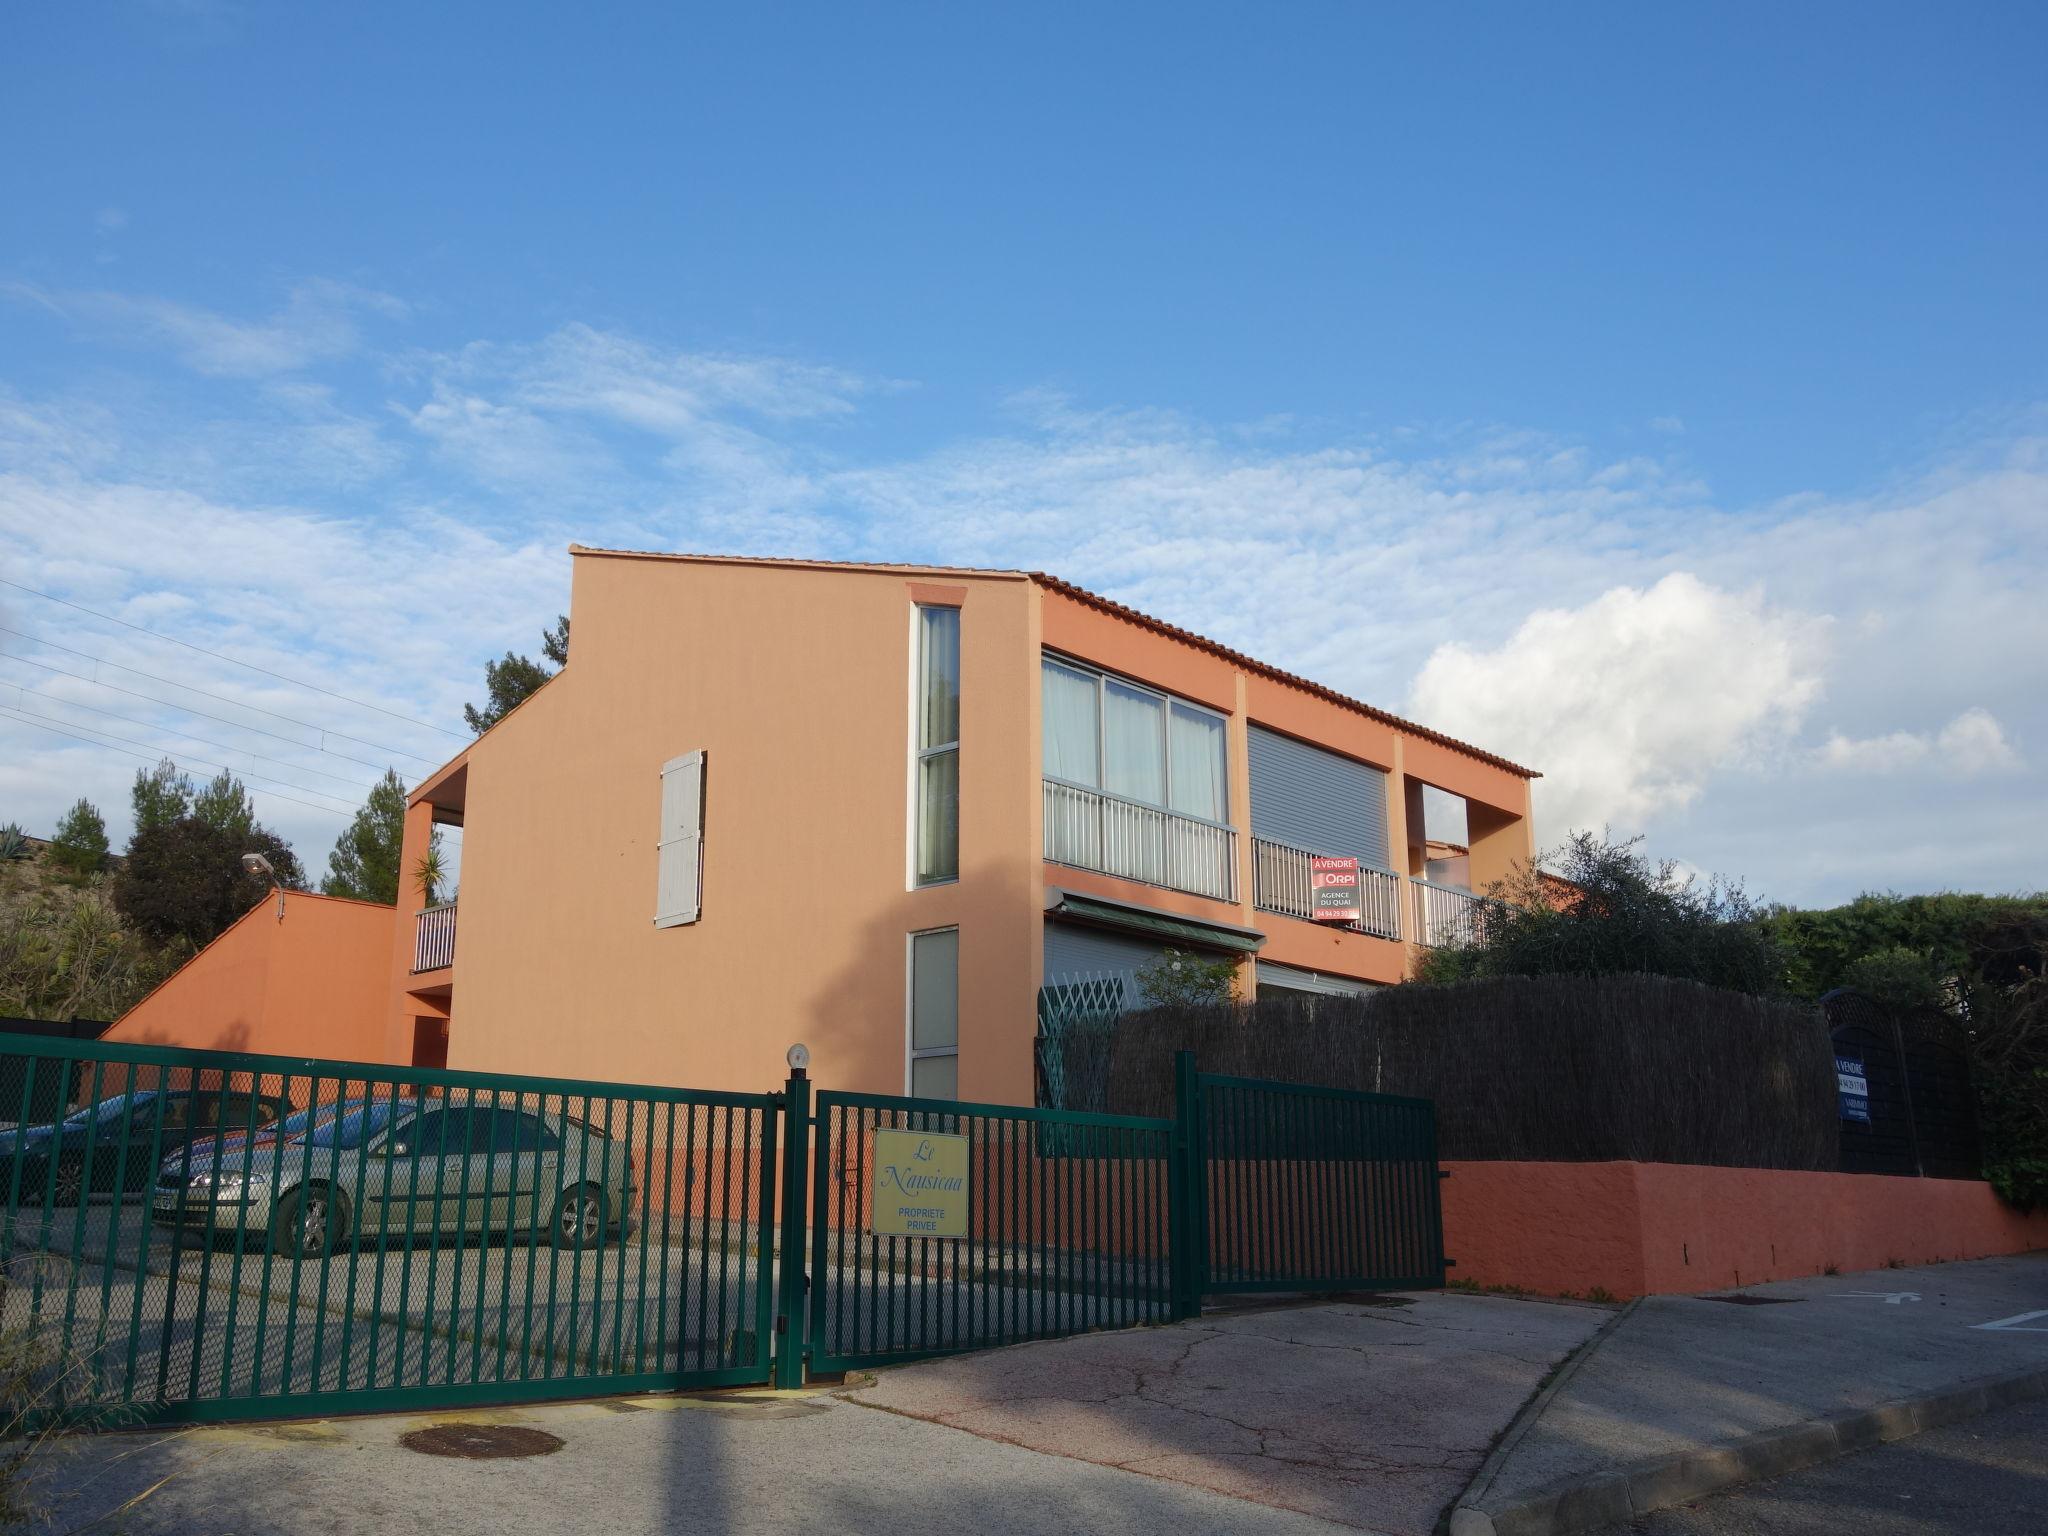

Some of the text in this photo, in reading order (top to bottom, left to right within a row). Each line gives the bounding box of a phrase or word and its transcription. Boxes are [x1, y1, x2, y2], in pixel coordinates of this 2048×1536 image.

[1321, 860, 1353, 868] VENDRE
[1840, 1061, 1864, 1075] VENDRE
[898, 1207, 945, 1219] PROPRIETE
[907, 1220, 937, 1231] PRIVEE
